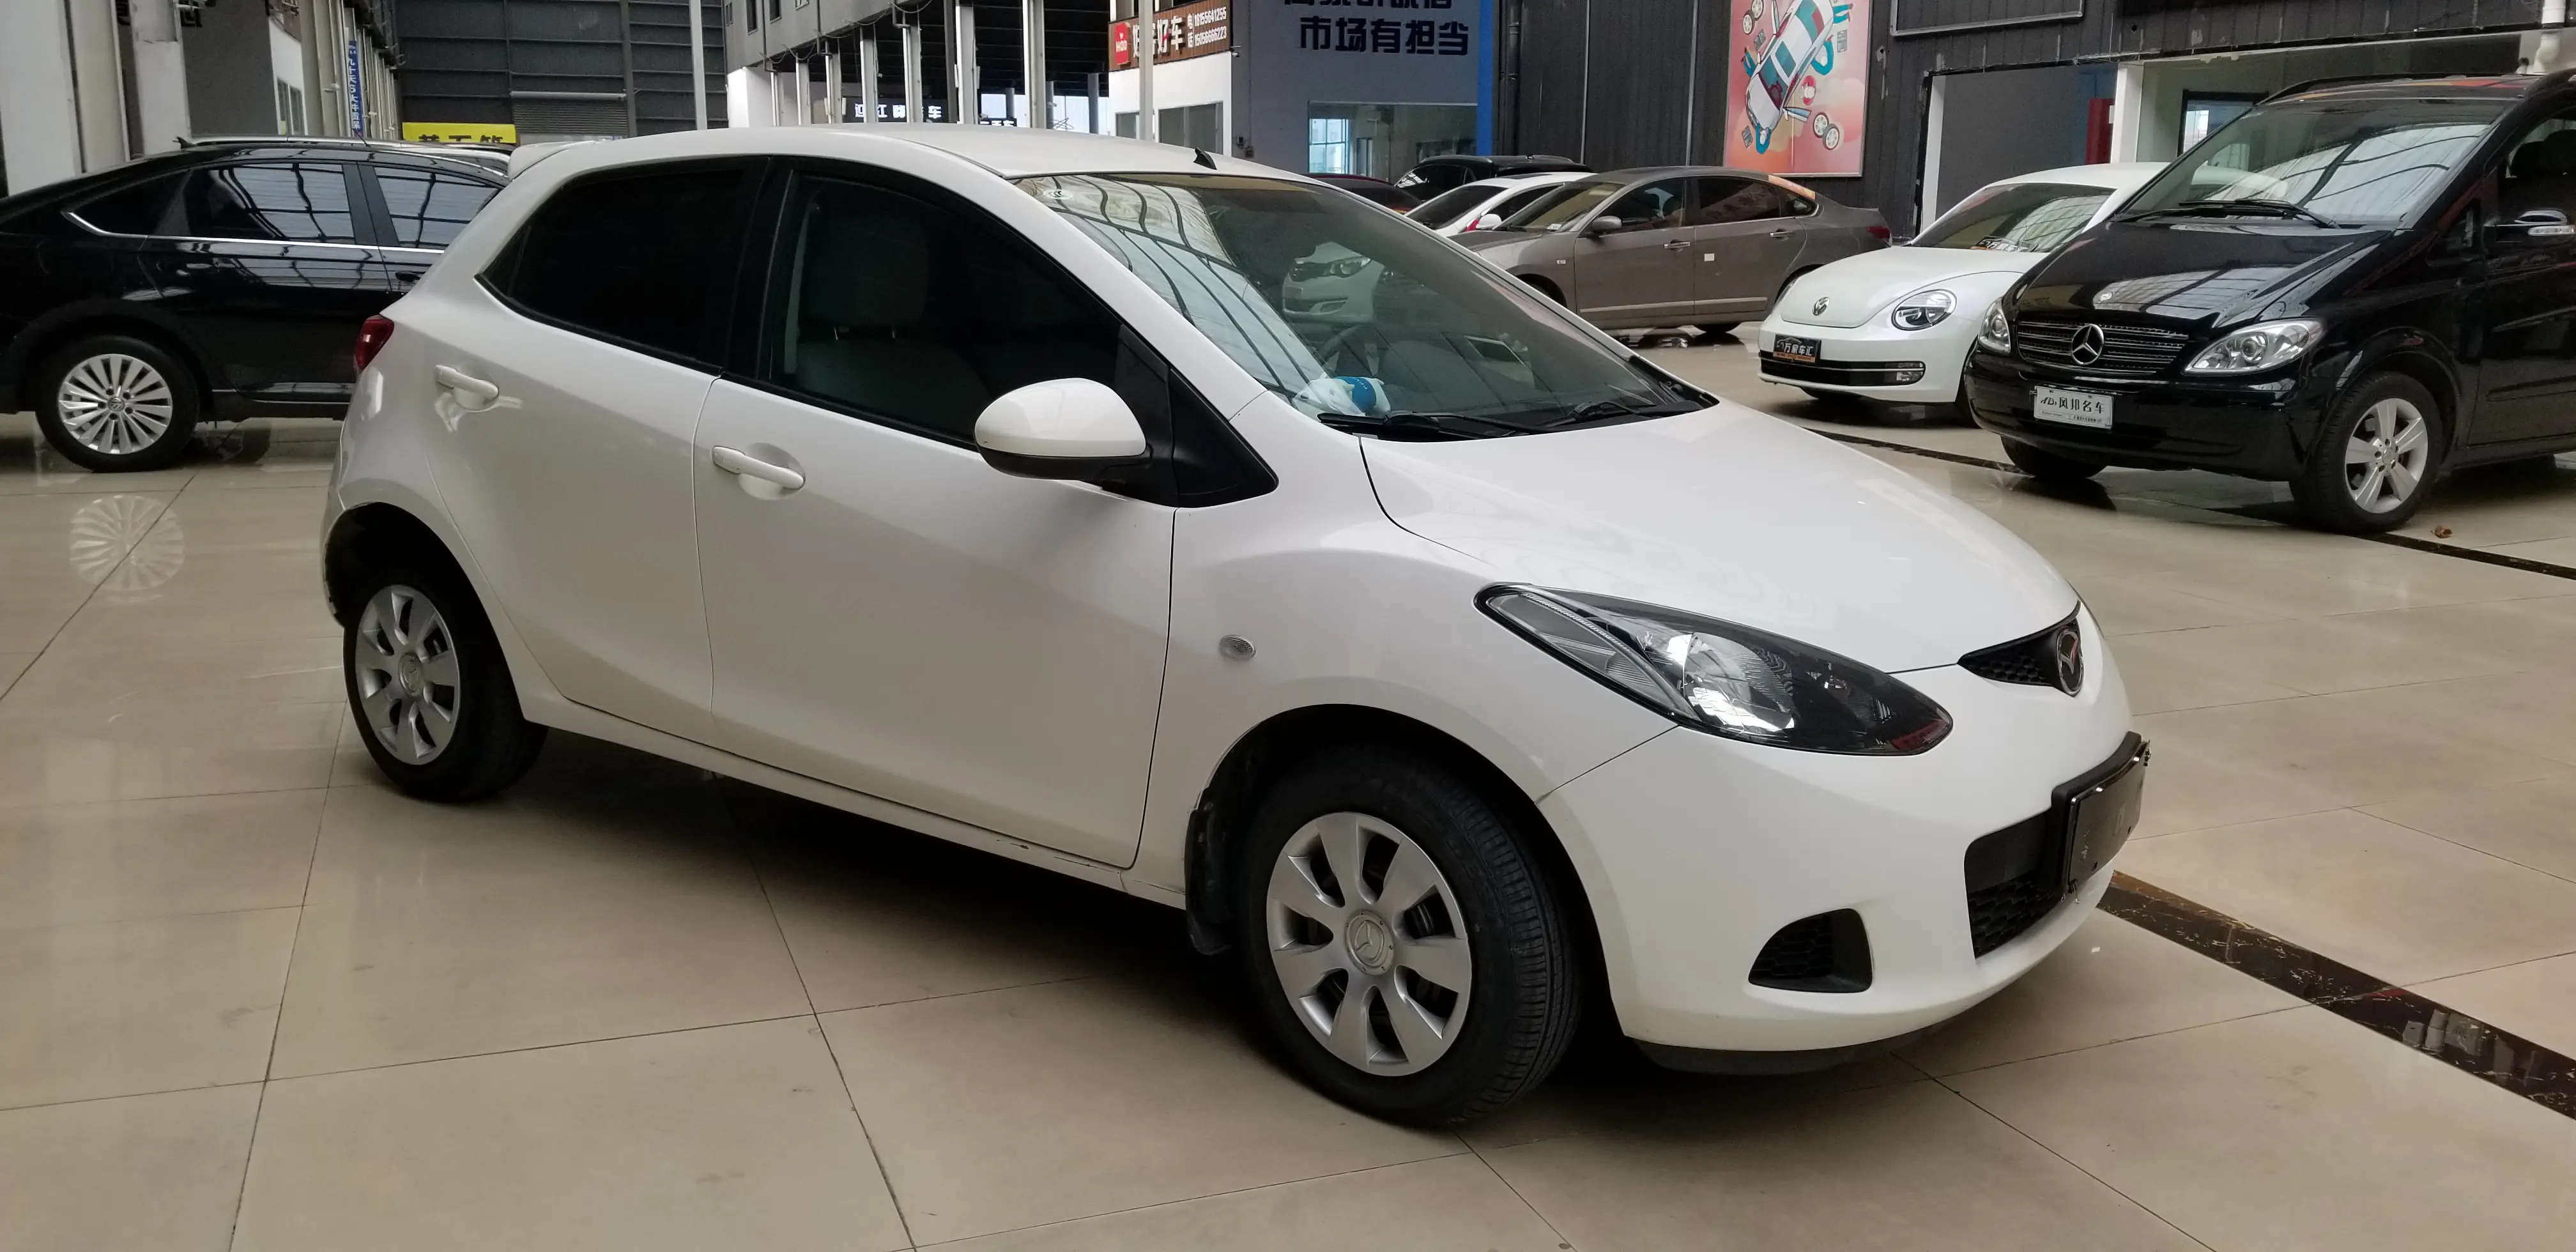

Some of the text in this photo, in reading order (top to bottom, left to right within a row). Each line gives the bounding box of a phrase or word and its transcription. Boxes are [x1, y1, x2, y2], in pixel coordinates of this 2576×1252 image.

[1300, 16, 1469, 56] 市场有担当
